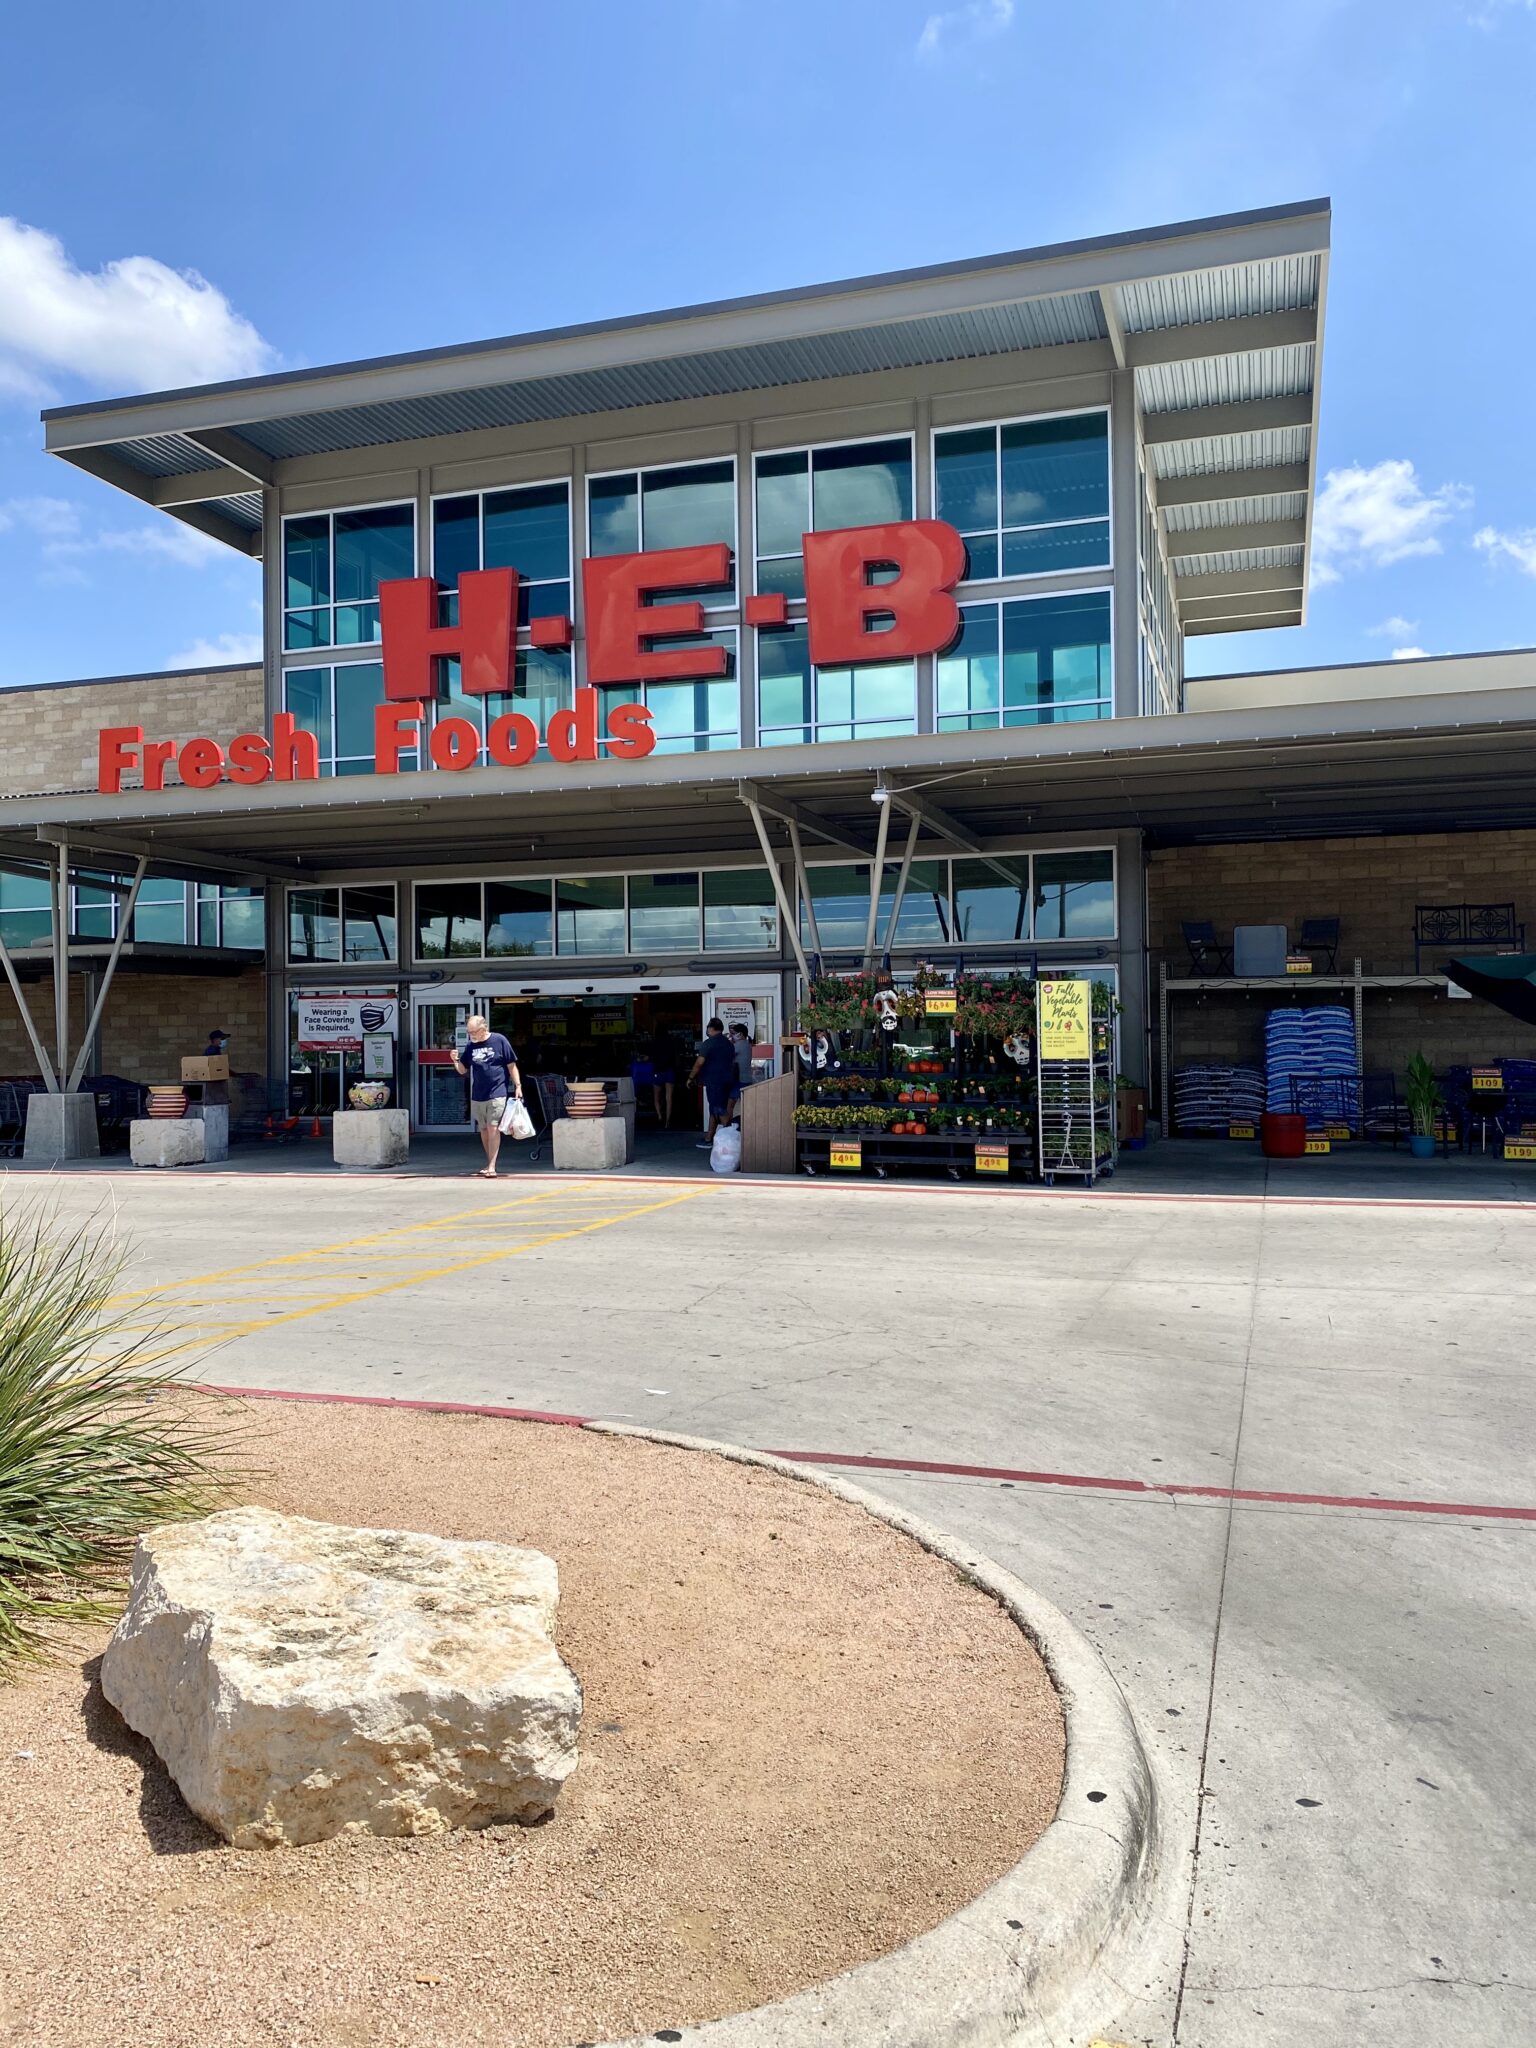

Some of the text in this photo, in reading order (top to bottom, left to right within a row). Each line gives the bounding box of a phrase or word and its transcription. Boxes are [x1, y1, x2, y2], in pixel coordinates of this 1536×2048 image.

[98, 687, 656, 795] Fresh Foods
[1056, 982, 1075, 996] Fall
[1046, 993, 1083, 1008] Vegetable
[311, 1008, 342, 1016] Wearing
[1052, 1006, 1078, 1018] Plants
[322, 1016, 355, 1024] Covering
[316, 1024, 350, 1032] Required.
